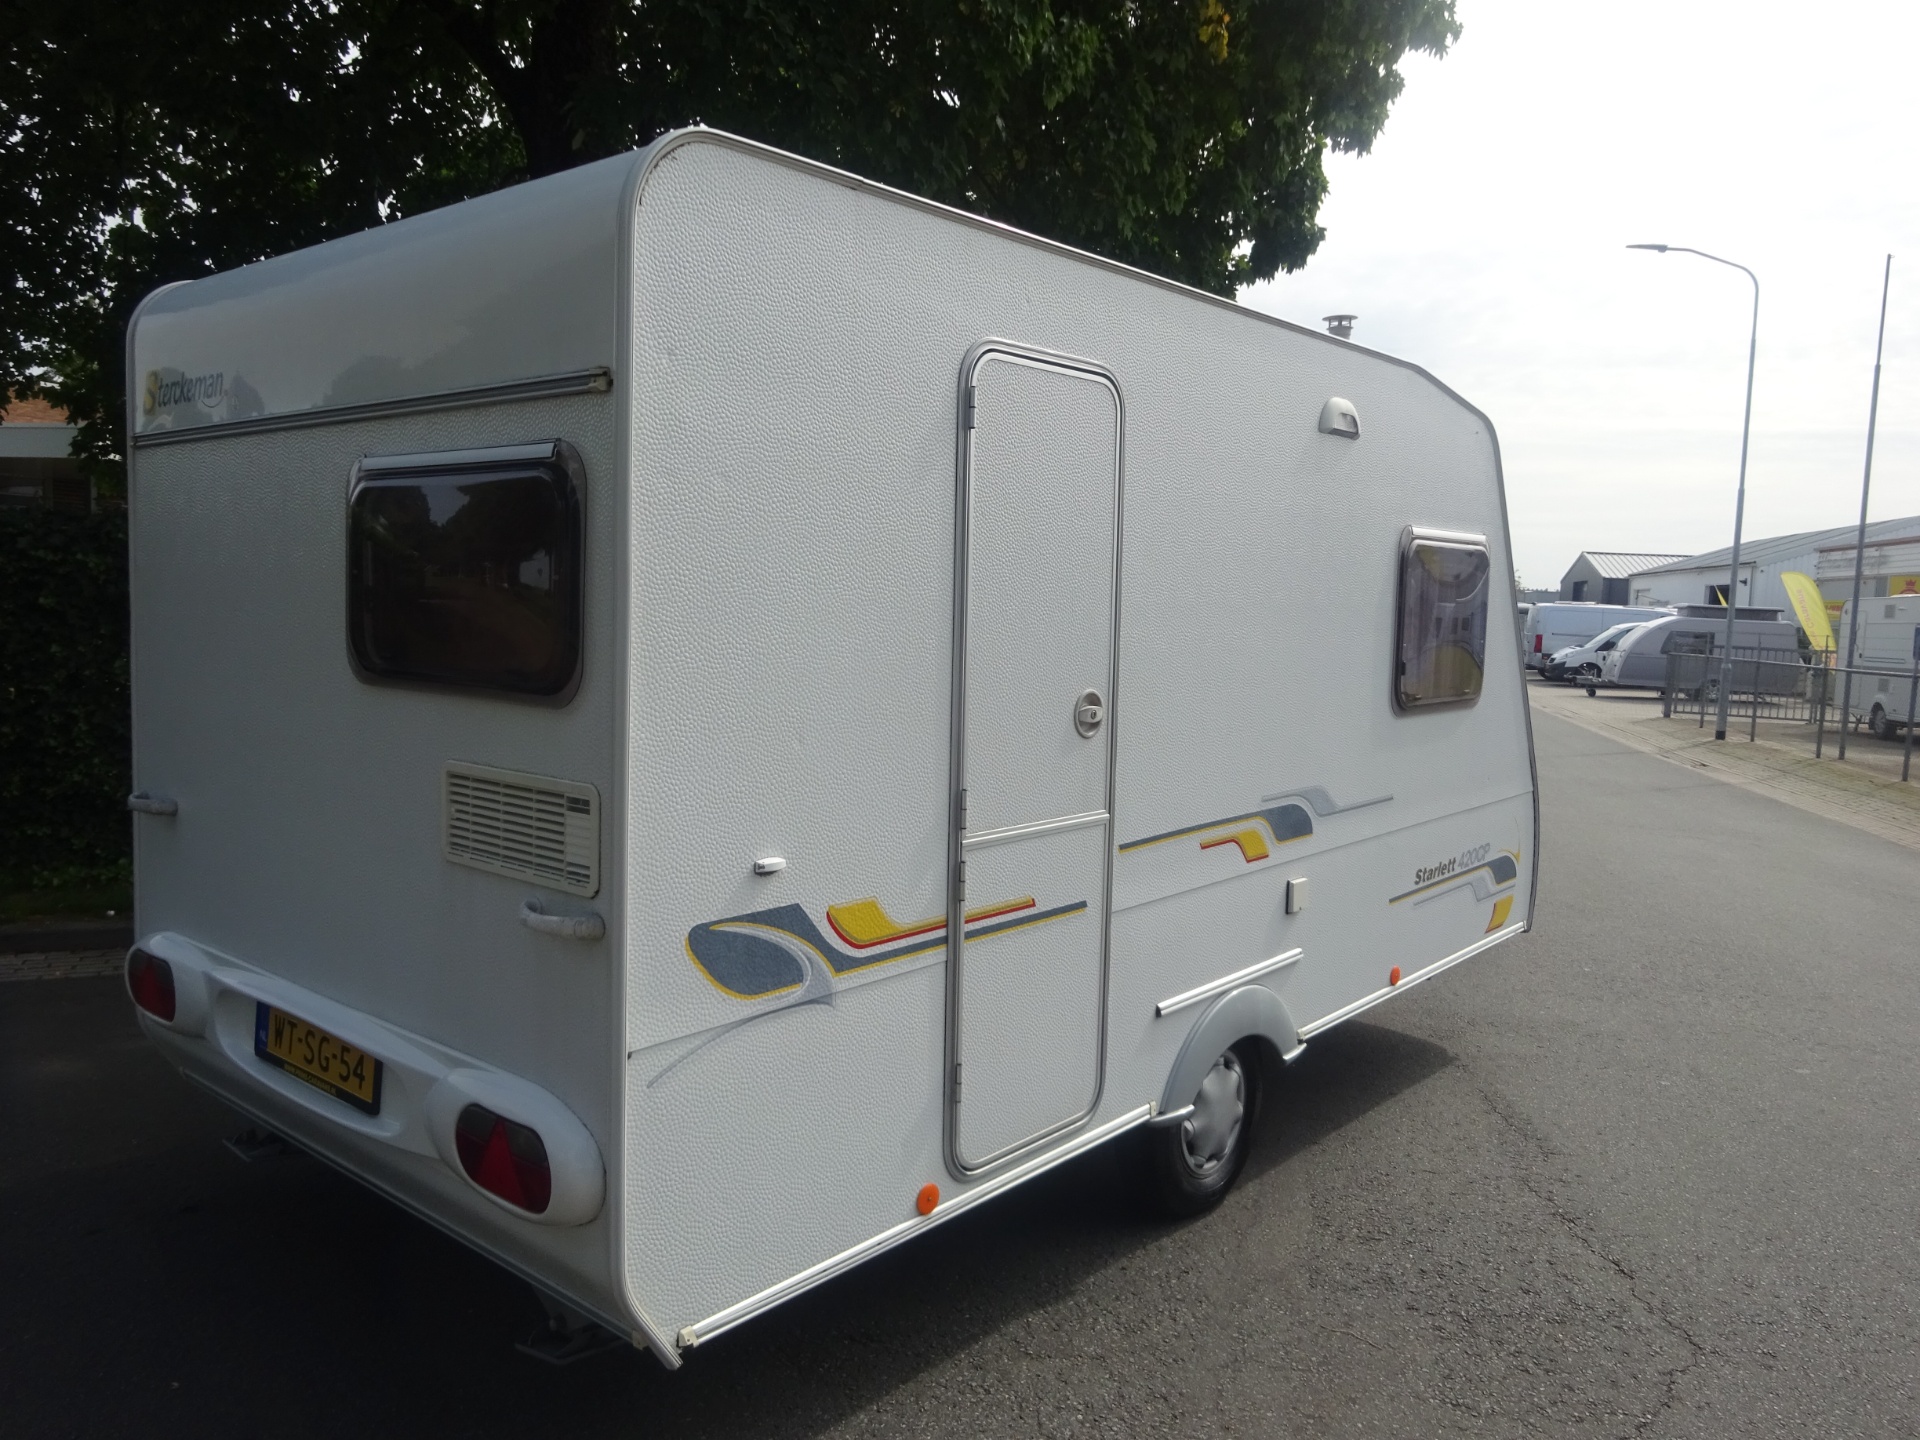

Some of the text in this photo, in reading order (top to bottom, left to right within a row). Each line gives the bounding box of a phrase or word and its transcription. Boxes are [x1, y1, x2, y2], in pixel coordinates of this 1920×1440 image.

[143, 369, 223, 416] Sterckeman
[1414, 857, 1457, 885] Starlett
[274, 1013, 366, 1091] WT-SG-54
